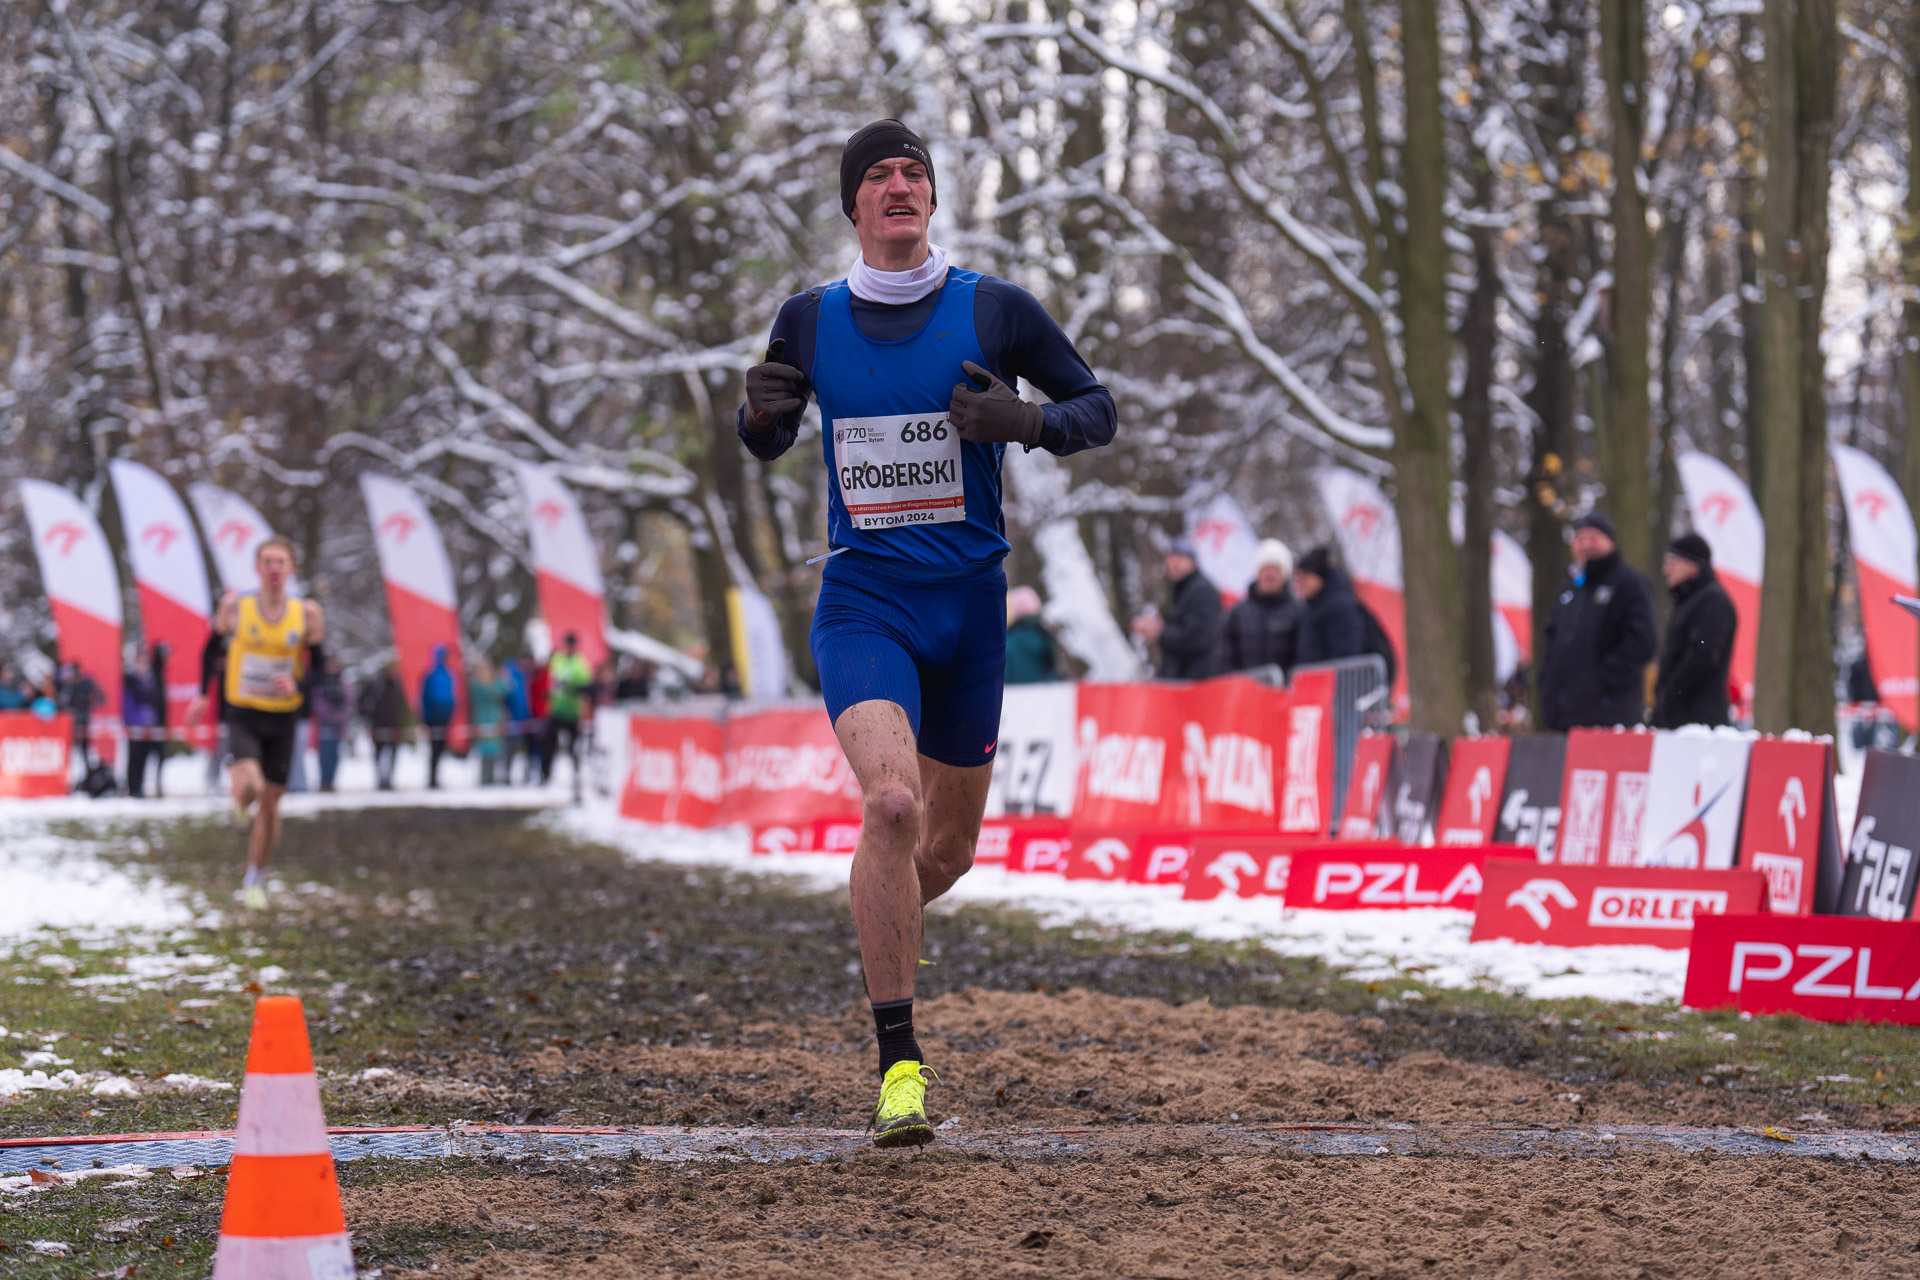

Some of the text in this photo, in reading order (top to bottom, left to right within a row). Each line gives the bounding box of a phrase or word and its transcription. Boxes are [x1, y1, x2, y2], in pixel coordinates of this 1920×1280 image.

[846, 427, 867, 439] 770
[900, 419, 948, 443] 686
[841, 459, 956, 490] GROBERSKI
[864, 512, 935, 526] BYTOM 2024
[1314, 863, 1484, 904] PZLA
[1601, 896, 1715, 920] ORLEN
